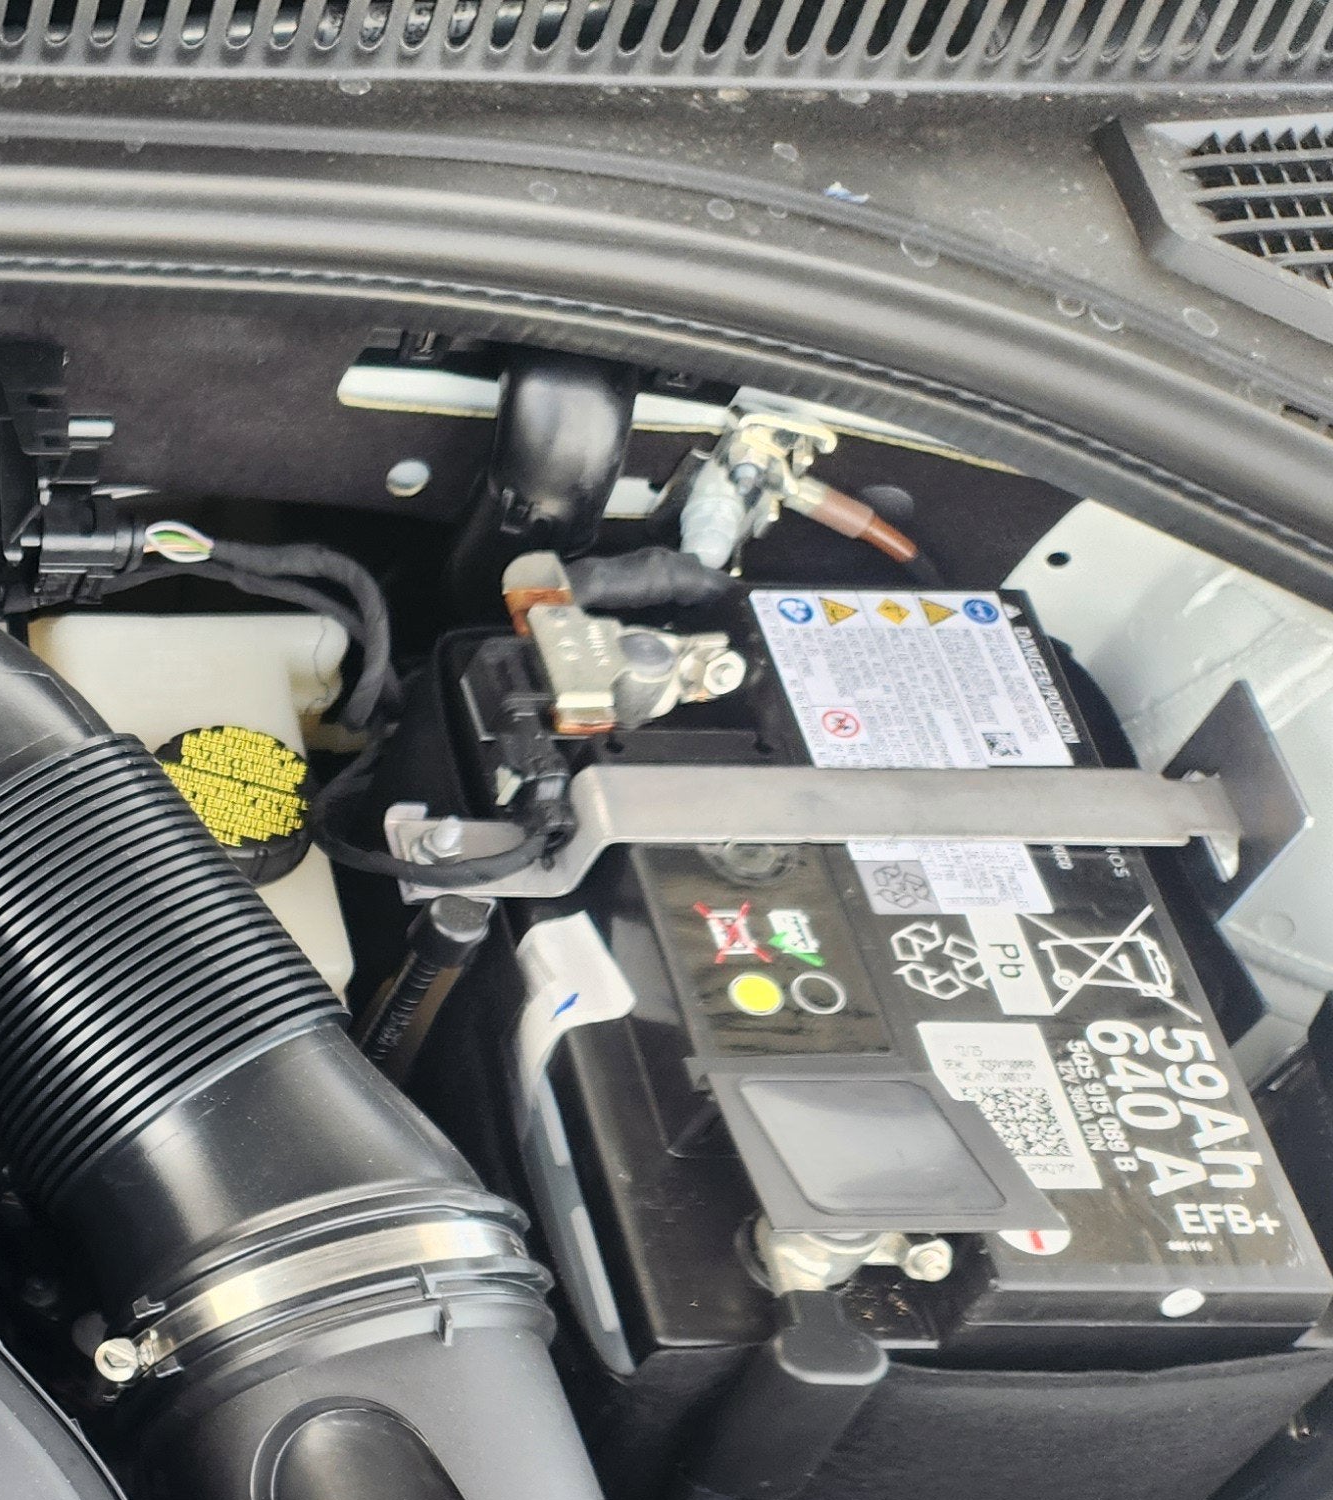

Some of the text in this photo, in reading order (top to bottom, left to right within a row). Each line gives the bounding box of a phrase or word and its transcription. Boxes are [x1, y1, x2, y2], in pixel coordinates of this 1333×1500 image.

[988, 941, 1024, 980] Pb
[1083, 1082, 1116, 1115] 915
[1085, 1019, 1182, 1131] 640
[1134, 1146, 1208, 1197] A
[1149, 1026, 1263, 1189] 59Ah
[1082, 1122, 1109, 1152] DIN
[1098, 1116, 1131, 1154] 089
[1113, 1156, 1139, 1173] B
[1173, 1203, 1281, 1236] EFB+
